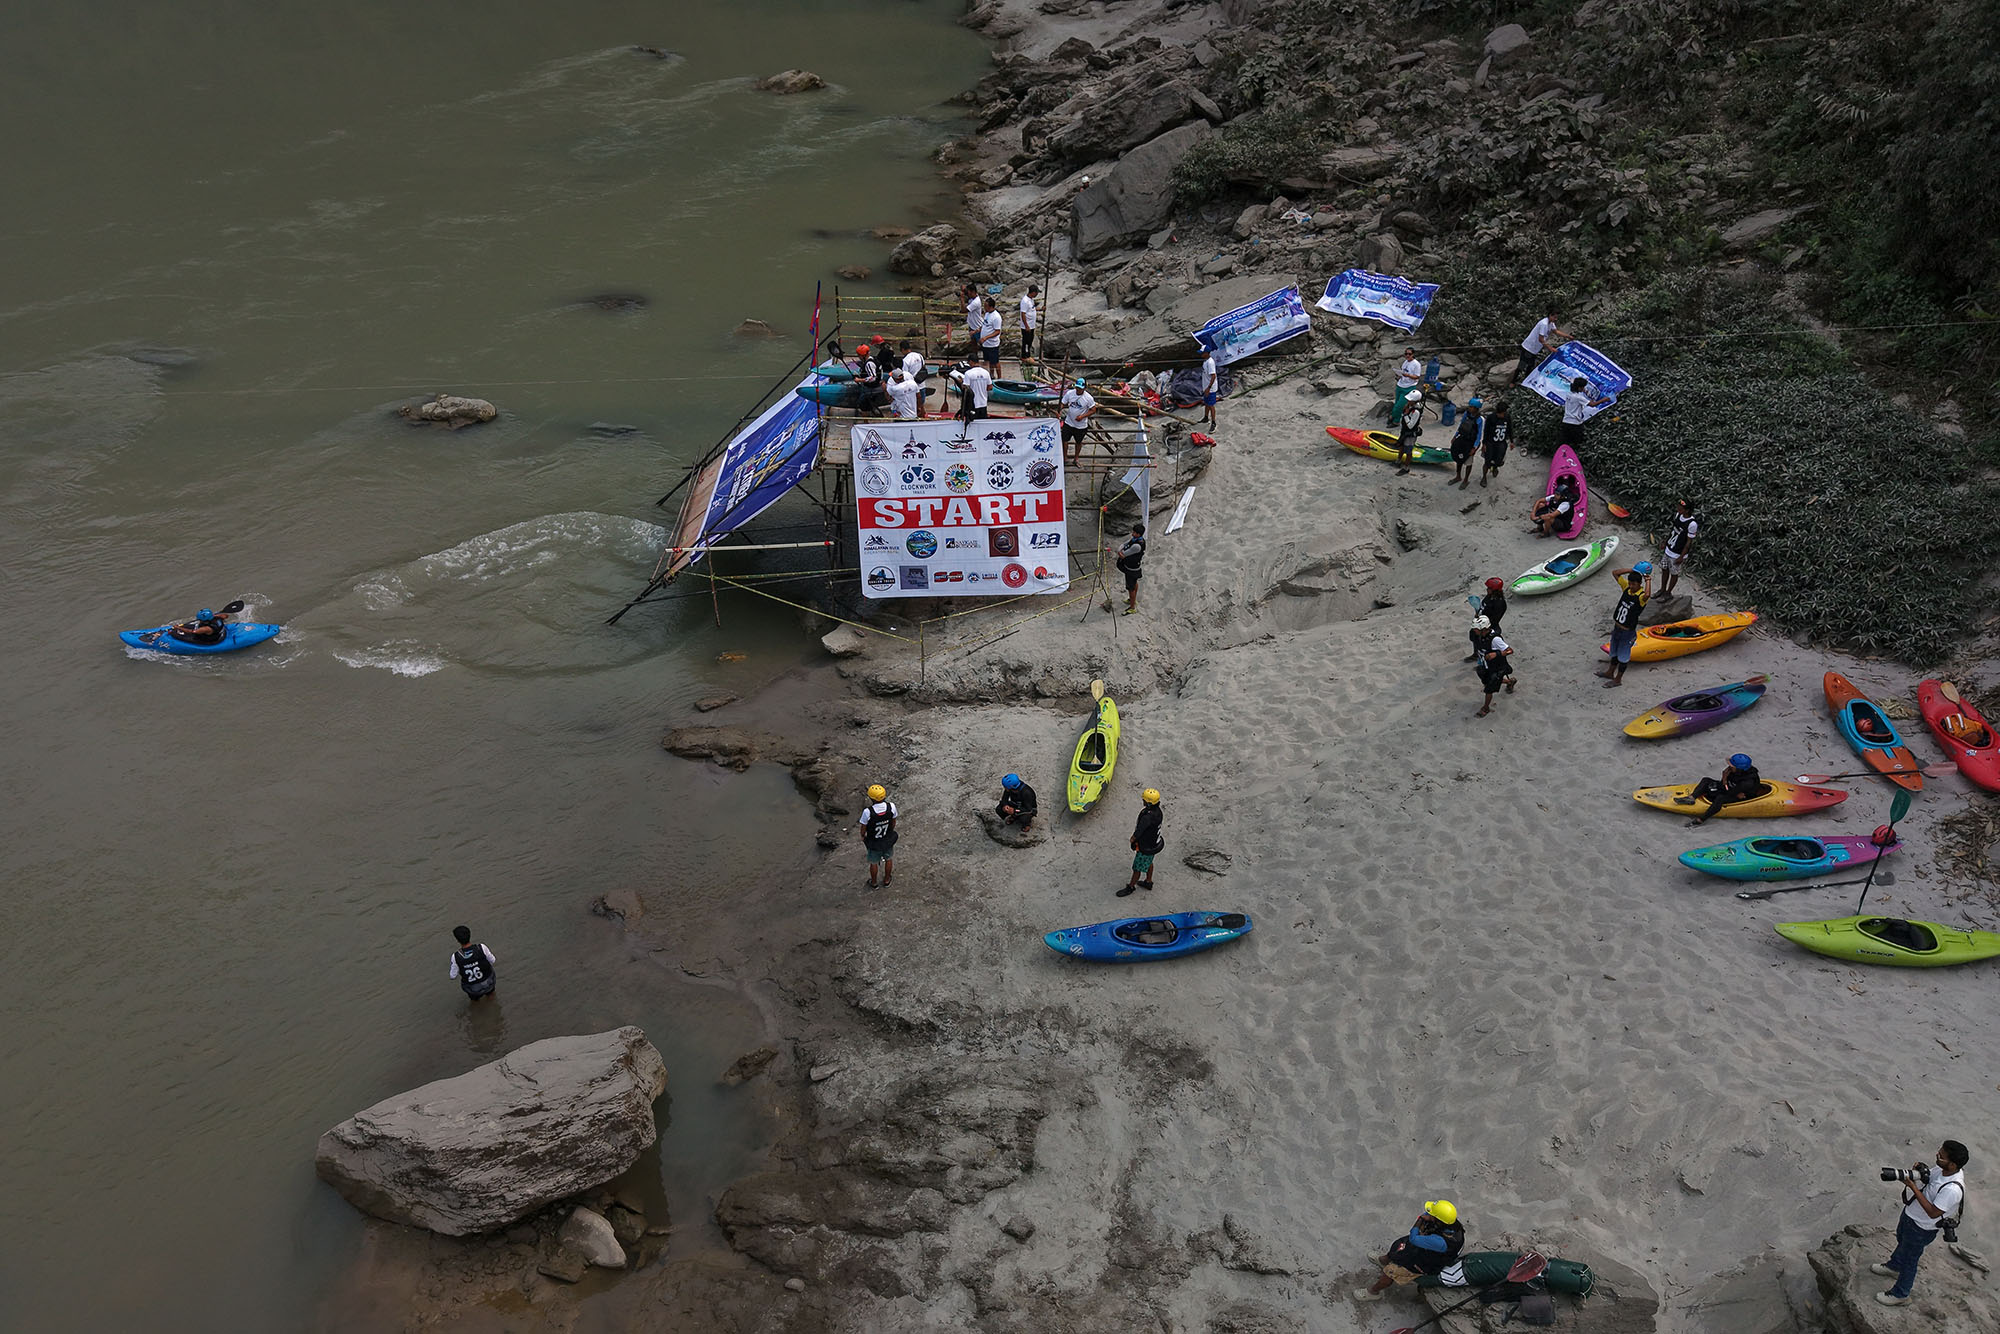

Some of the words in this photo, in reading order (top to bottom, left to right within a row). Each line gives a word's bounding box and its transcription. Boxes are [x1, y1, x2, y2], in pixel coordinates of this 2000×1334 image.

[1493, 428, 1506, 441] 35
[873, 492, 1048, 527] START
[1667, 530, 1679, 549] 14
[1615, 605, 1628, 624] 18
[875, 824, 889, 839] 27
[1760, 865, 1788, 873] pyranha
[464, 966, 483, 983] 26
